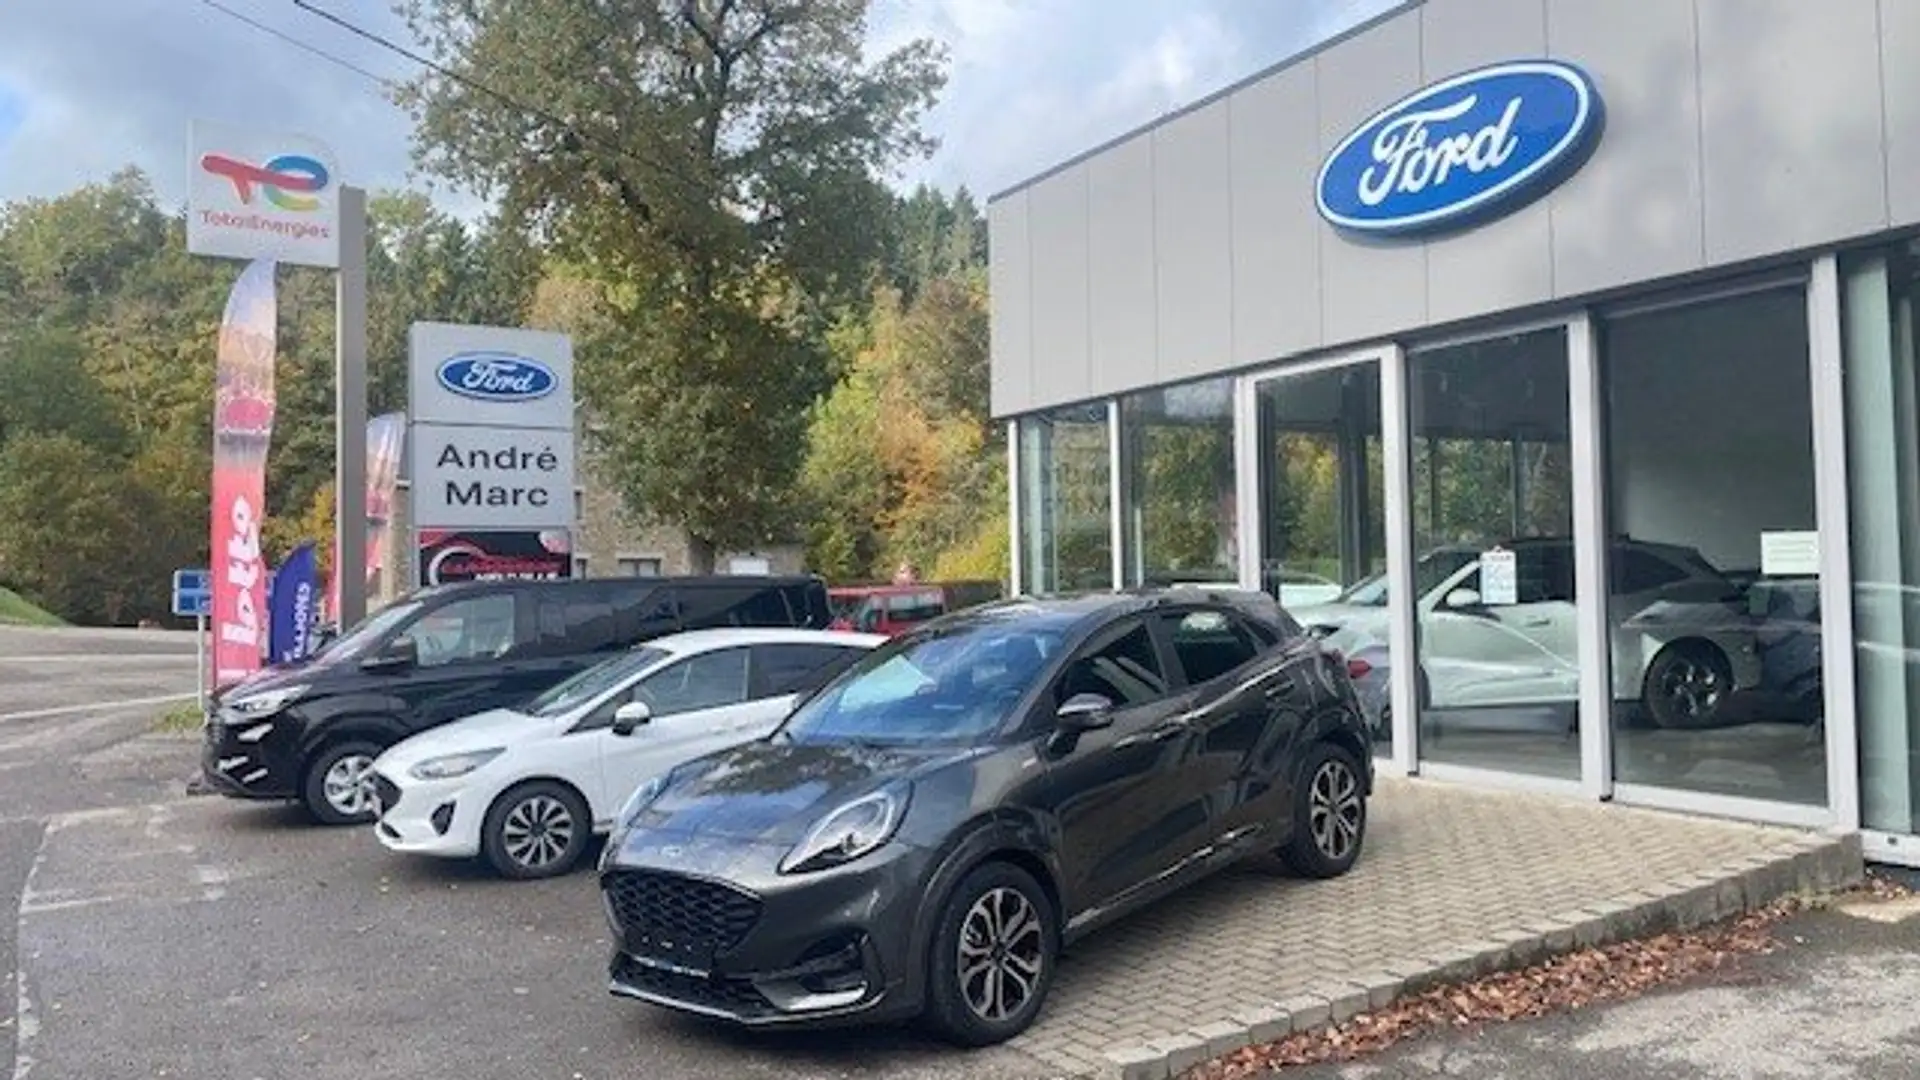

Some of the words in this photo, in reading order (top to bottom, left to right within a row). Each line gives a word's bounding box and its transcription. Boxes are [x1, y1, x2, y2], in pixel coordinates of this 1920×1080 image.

[1358, 94, 1523, 206] Ford
[462, 361, 535, 392] Ford
[436, 443, 557, 471] André
[445, 480, 549, 507] Marc
[222, 494, 260, 645] lotto
